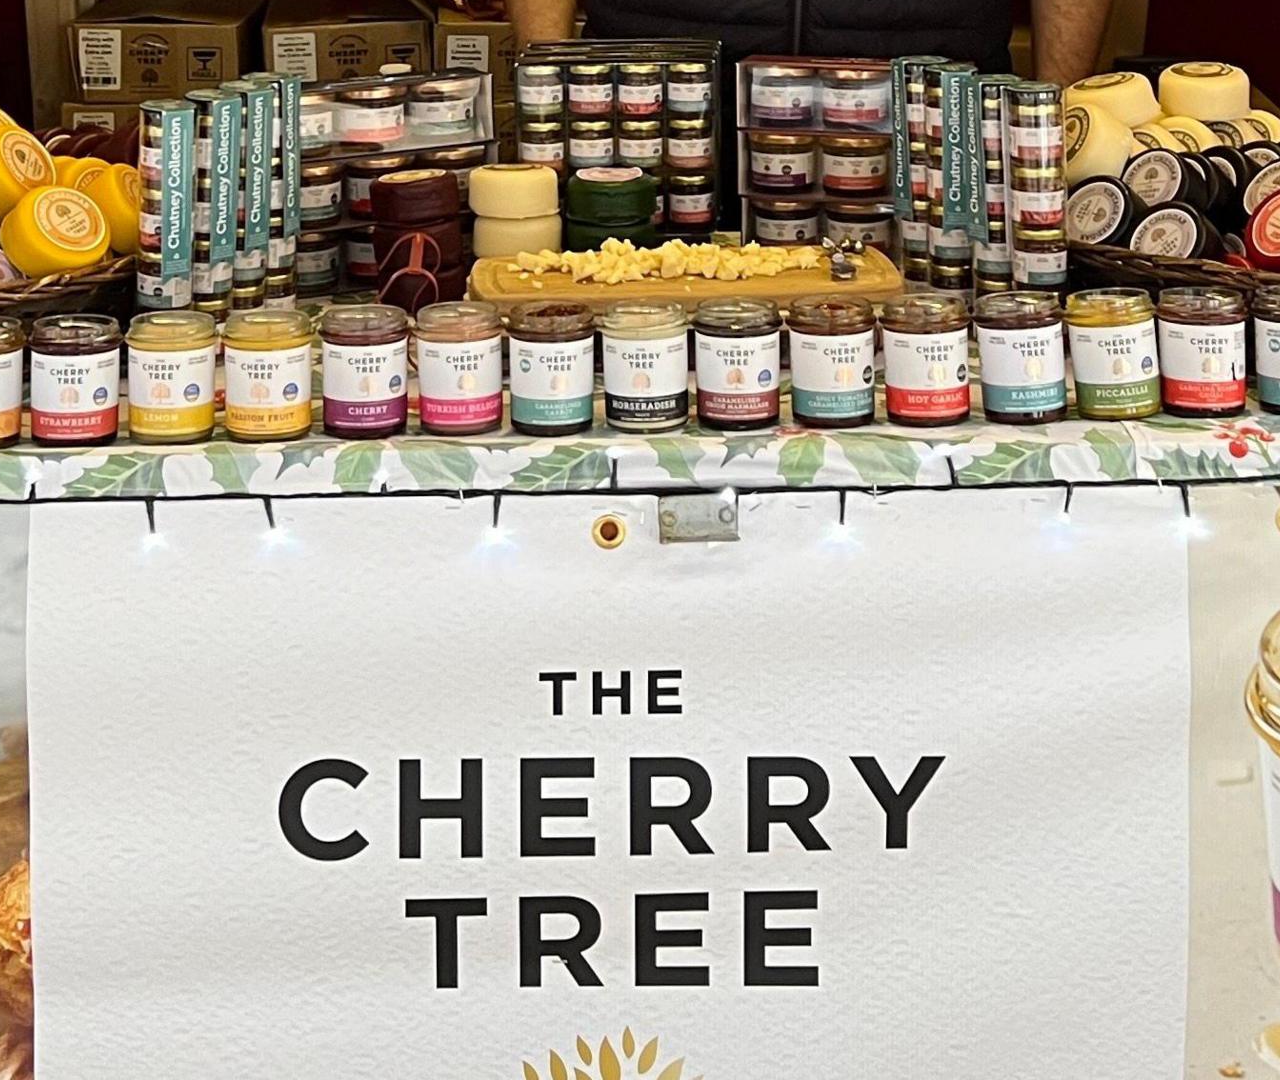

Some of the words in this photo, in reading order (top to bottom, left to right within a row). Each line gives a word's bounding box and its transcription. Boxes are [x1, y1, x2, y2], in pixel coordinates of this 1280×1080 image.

[328, 49, 368, 58] CHERRY
[948, 77, 961, 144] Collection
[968, 87, 978, 153] Collection
[250, 96, 264, 165] Collection
[216, 104, 231, 174] Collection
[167, 117, 182, 188] Collection
[949, 146, 964, 202] Chutney
[970, 154, 982, 213] Chutney
[250, 166, 264, 224] Chutney
[215, 175, 232, 235] Chutney
[167, 190, 184, 249] Chutney
[716, 349, 755, 358] CHERRY
[348, 356, 388, 366] CHERRY
[723, 357, 749, 366] TREE
[50, 368, 91, 377] CHERRY
[355, 364, 381, 374] TREE
[57, 376, 84, 385] TREE
[907, 393, 927, 404] HOT
[929, 392, 964, 403] GARLIC
[1011, 388, 1058, 401] KASHMIRI
[1095, 386, 1149, 398] PICCALILLI
[348, 405, 388, 416] CHERRY
[427, 402, 467, 413] TURKISH
[612, 399, 678, 411] HORSERADISH
[39, 415, 103, 428] STRAWBERRY
[143, 412, 179, 422] LEMON
[230, 412, 266, 422] PASSION
[268, 411, 296, 421] FRUIT
[538, 669, 683, 716] THE
[278, 754, 947, 862] CHERRY
[404, 889, 820, 989] TREE
